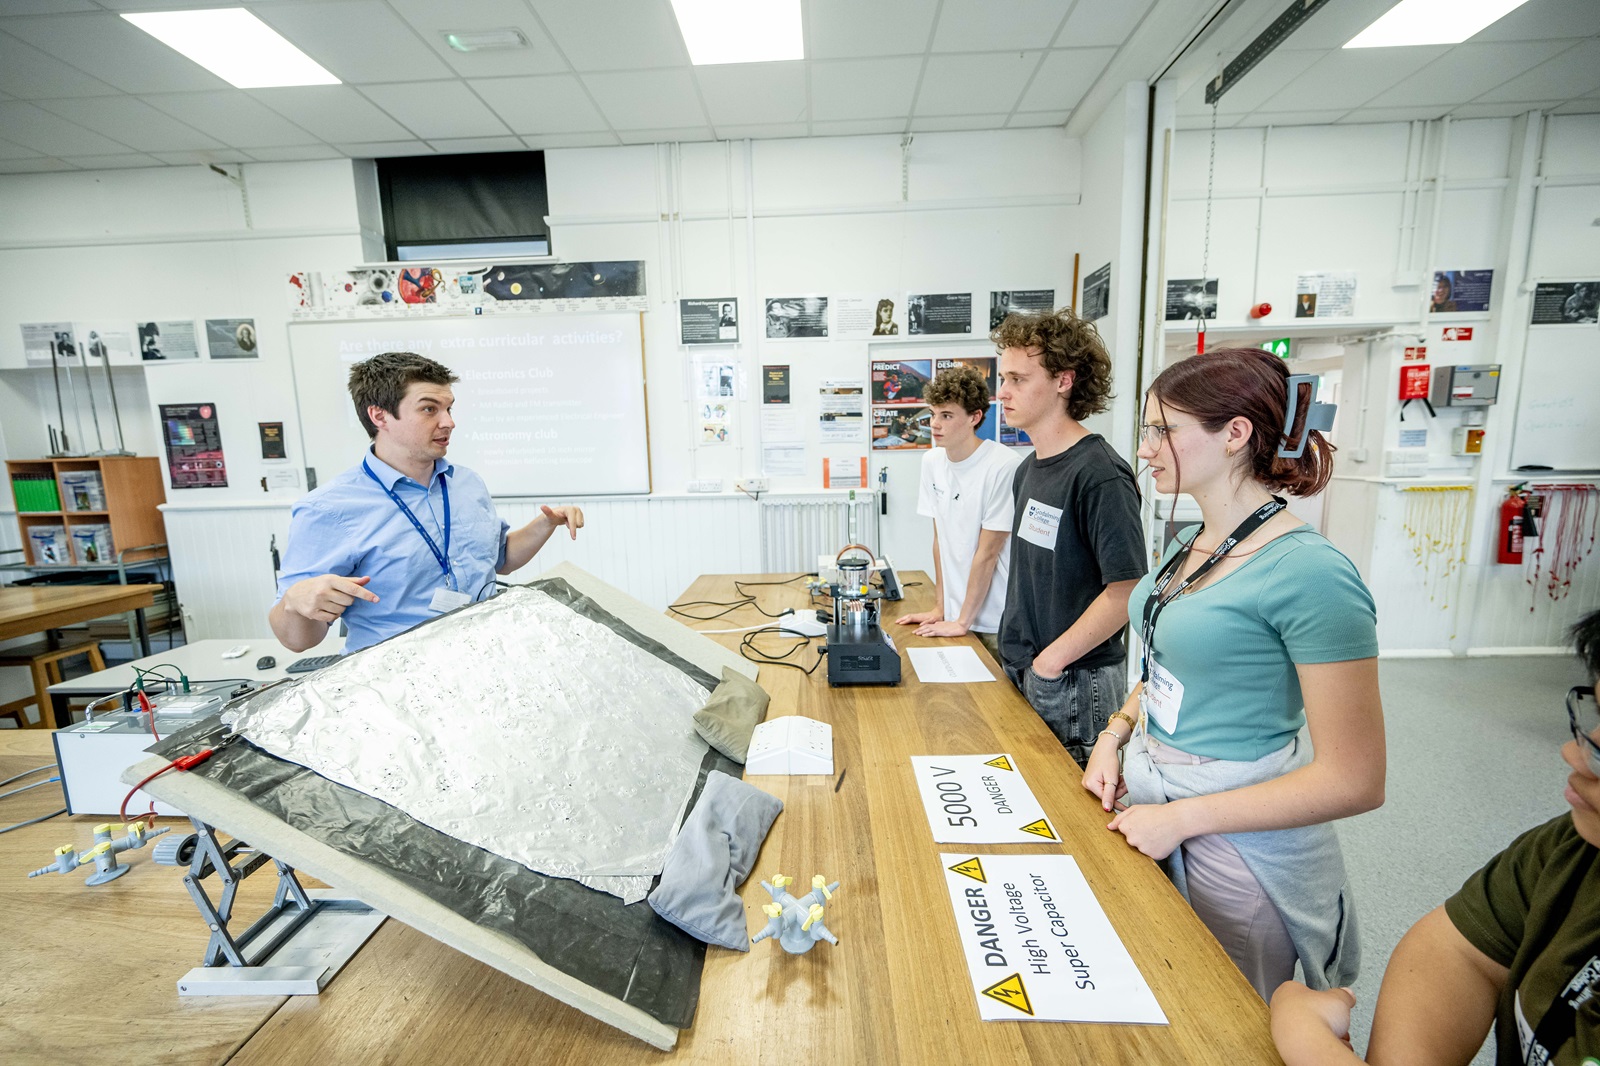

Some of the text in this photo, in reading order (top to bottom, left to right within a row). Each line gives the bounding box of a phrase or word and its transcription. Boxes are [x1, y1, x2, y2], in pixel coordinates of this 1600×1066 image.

[339, 330, 623, 354] Are there any extra curricular activities?
[465, 367, 554, 381] Electronics Club
[937, 361, 963, 369] DESIGN
[472, 429, 558, 442] Astronomy club
[1034, 514, 1050, 524] College
[1036, 508, 1060, 523] Godalming
[1029, 523, 1050, 536] Student
[930, 765, 978, 828] 5000 V
[983, 775, 1013, 814] DANGER
[965, 887, 1008, 967] DANGER
[1004, 882, 1051, 975] High Voltage
[1029, 873, 1095, 991] Super Capacitor
